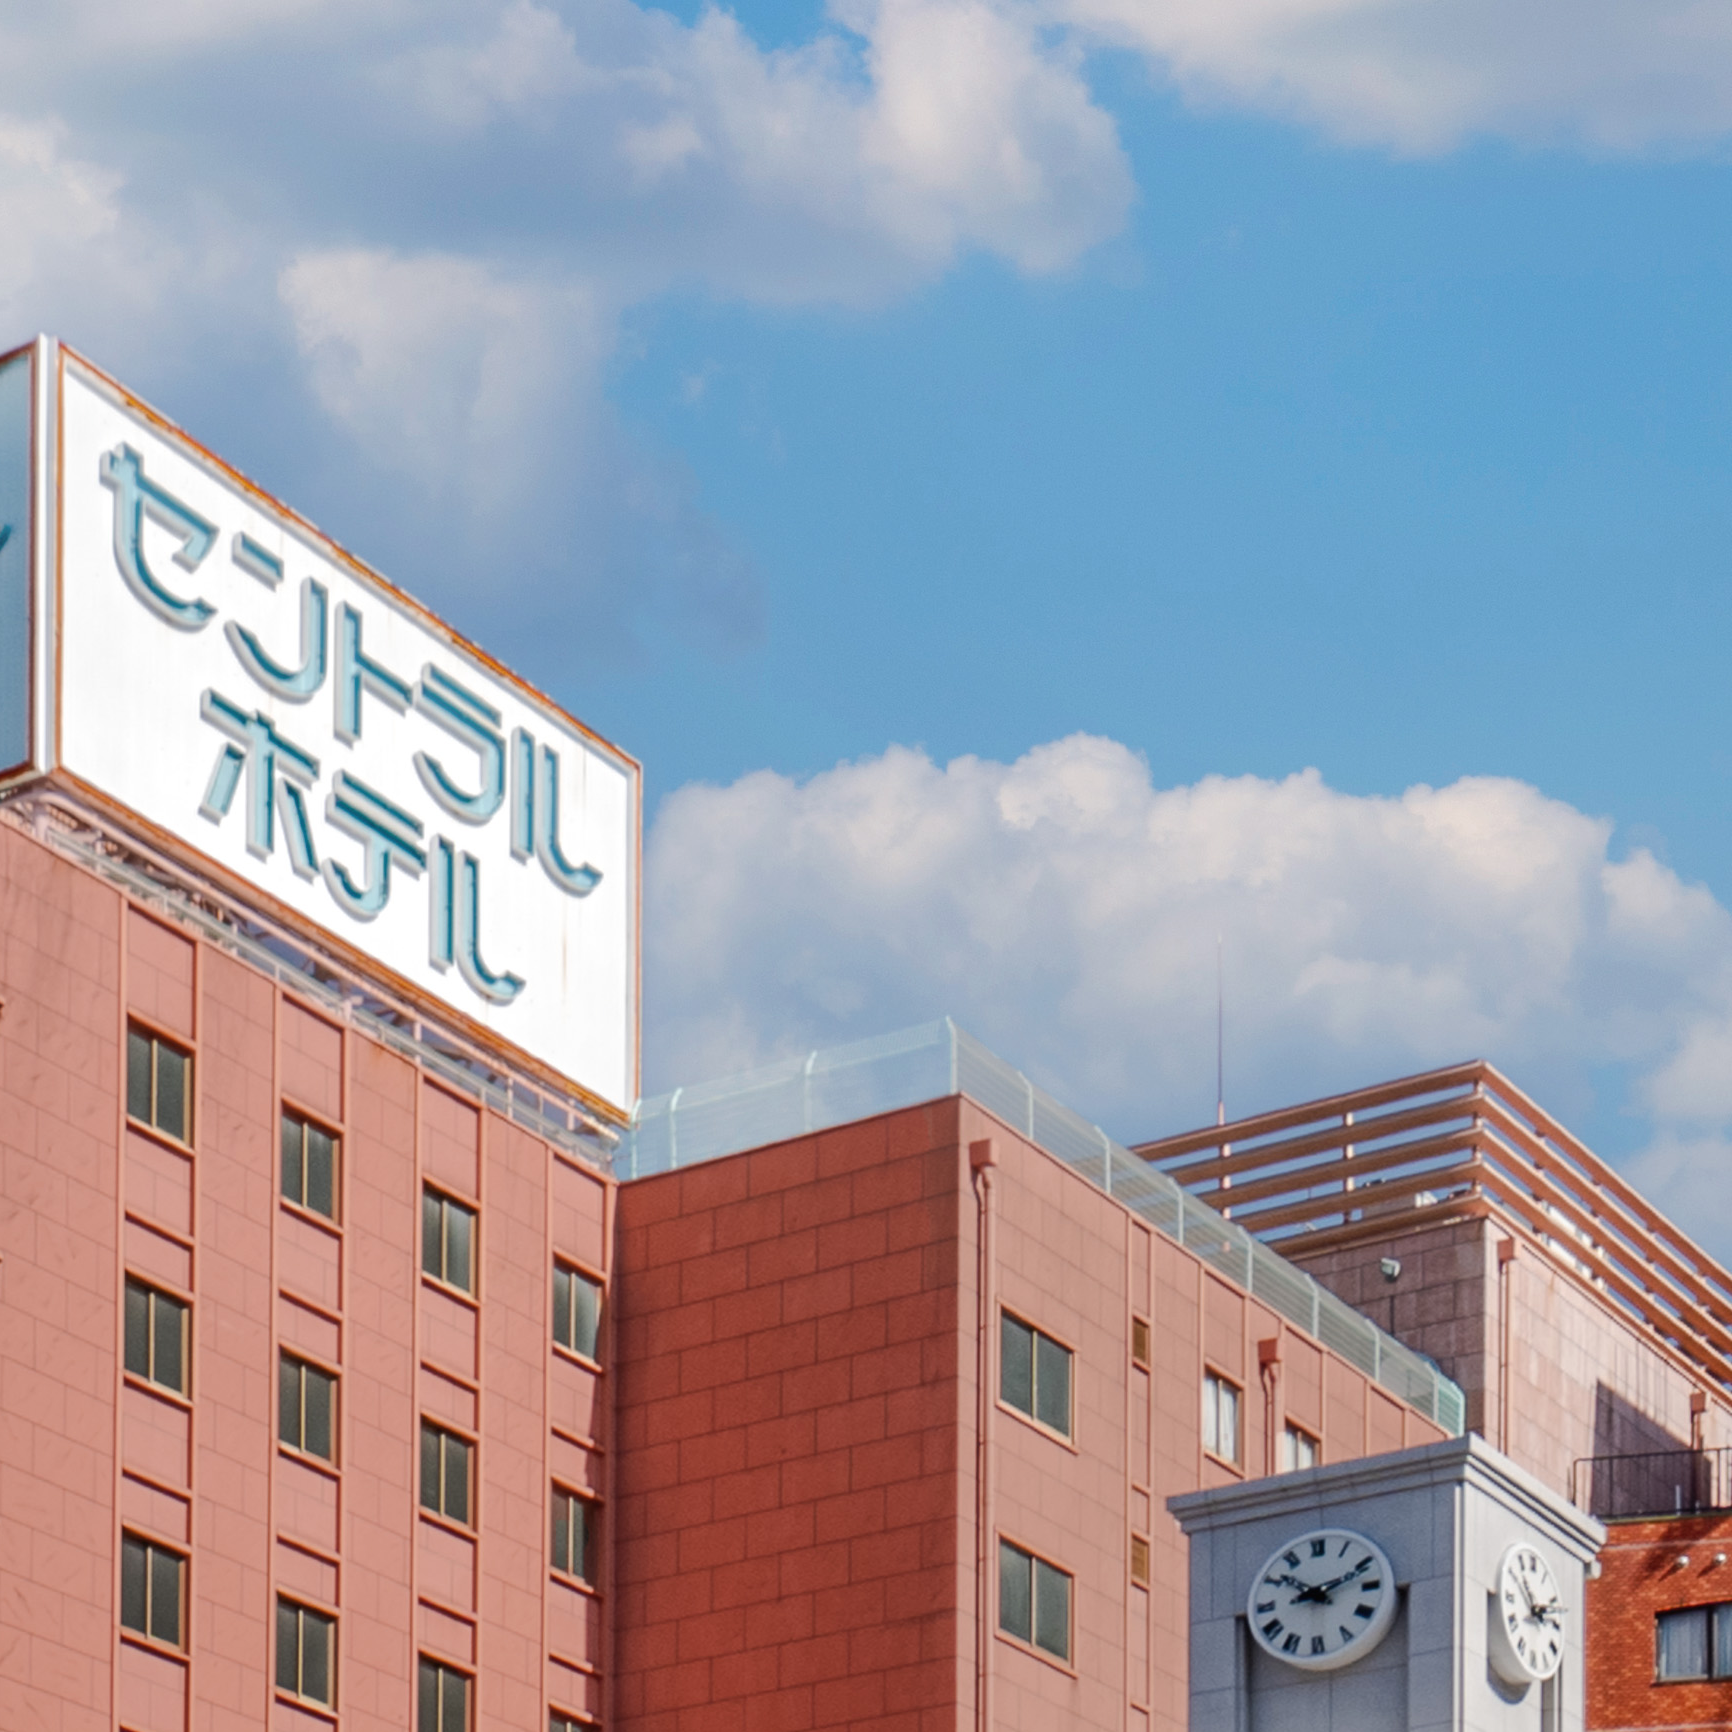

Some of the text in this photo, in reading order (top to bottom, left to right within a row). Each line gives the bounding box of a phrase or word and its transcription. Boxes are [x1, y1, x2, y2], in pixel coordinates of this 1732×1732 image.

[99, 440, 603, 898] セントラル
[199, 687, 526, 1006] ホテル
